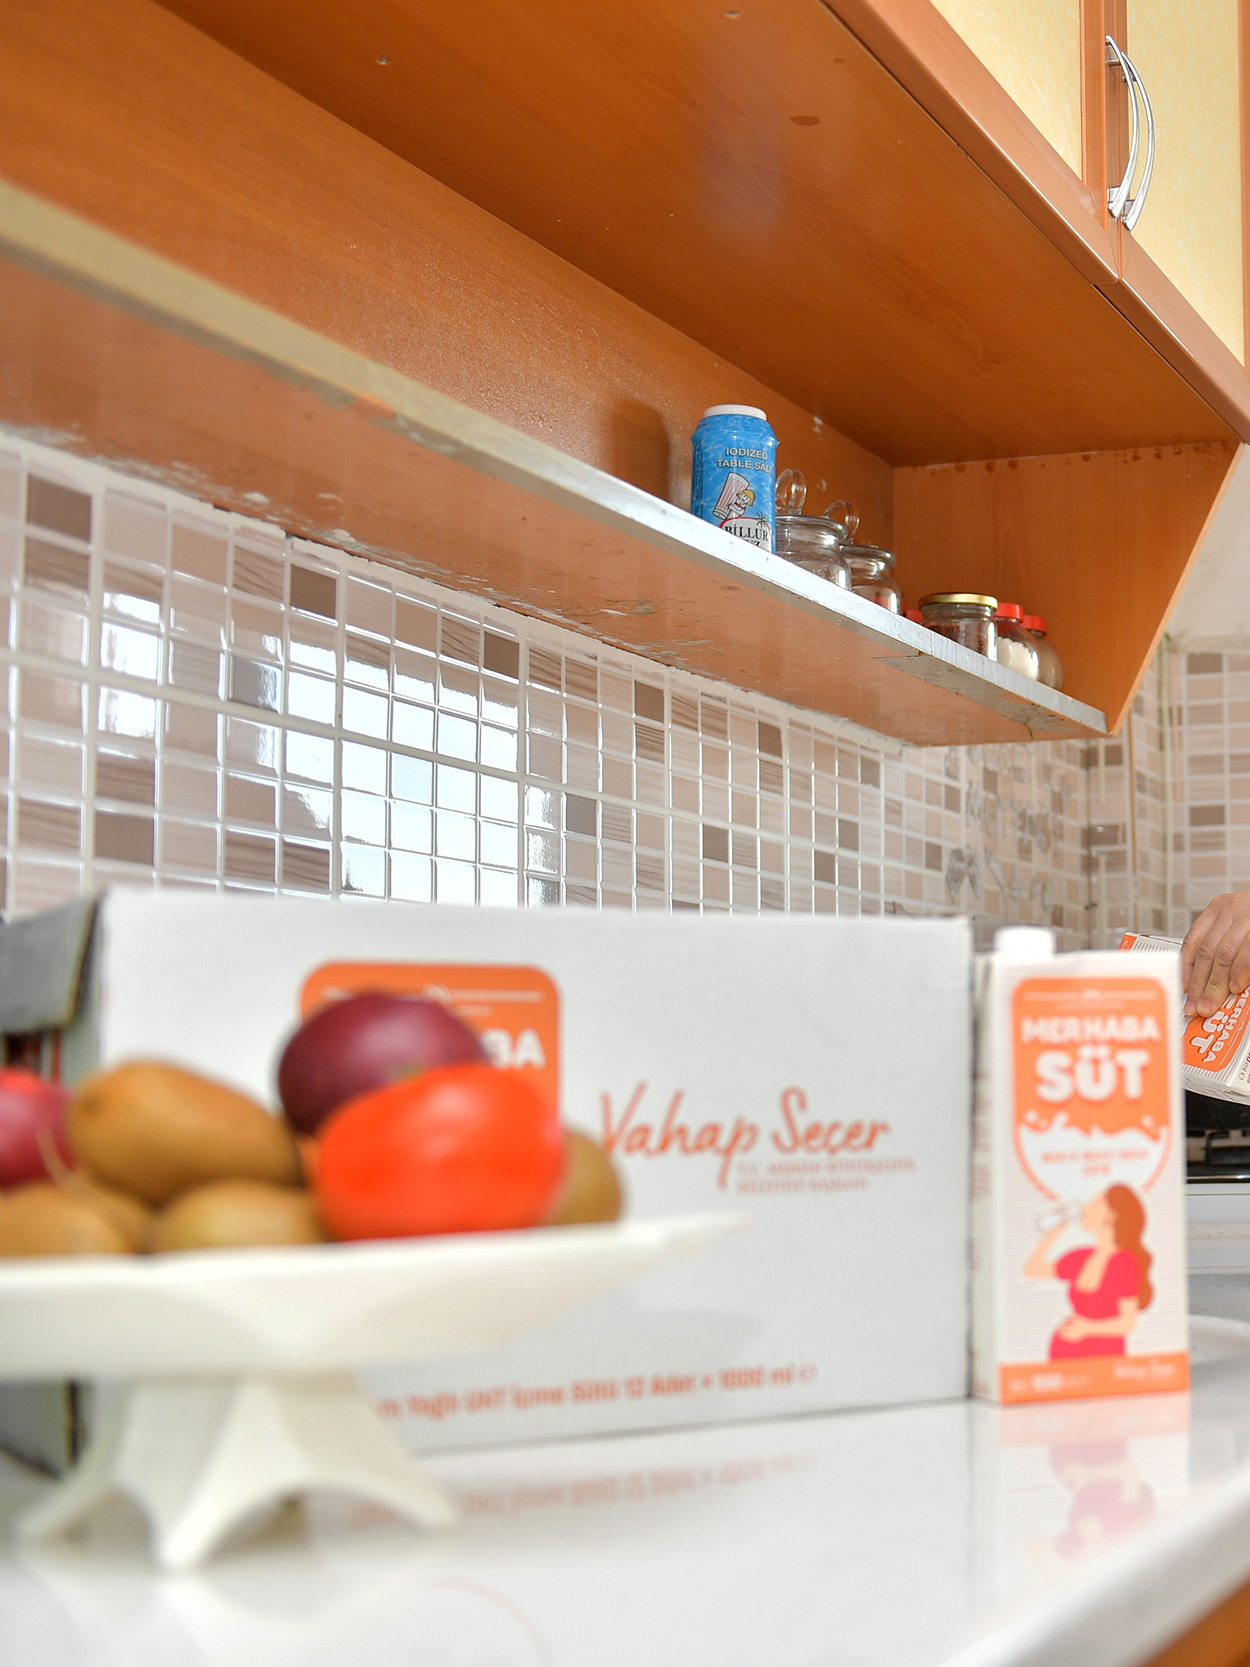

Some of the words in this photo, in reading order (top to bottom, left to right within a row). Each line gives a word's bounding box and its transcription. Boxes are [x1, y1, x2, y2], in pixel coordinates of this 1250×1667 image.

[717, 459, 752, 469] TABLE
[753, 461, 774, 474] SALT
[725, 447, 768, 460] IODIZED
[1021, 1015, 1161, 1042] MERHABA
[1035, 1045, 1150, 1101] SÜT
[600, 1081, 759, 1190] Vahap
